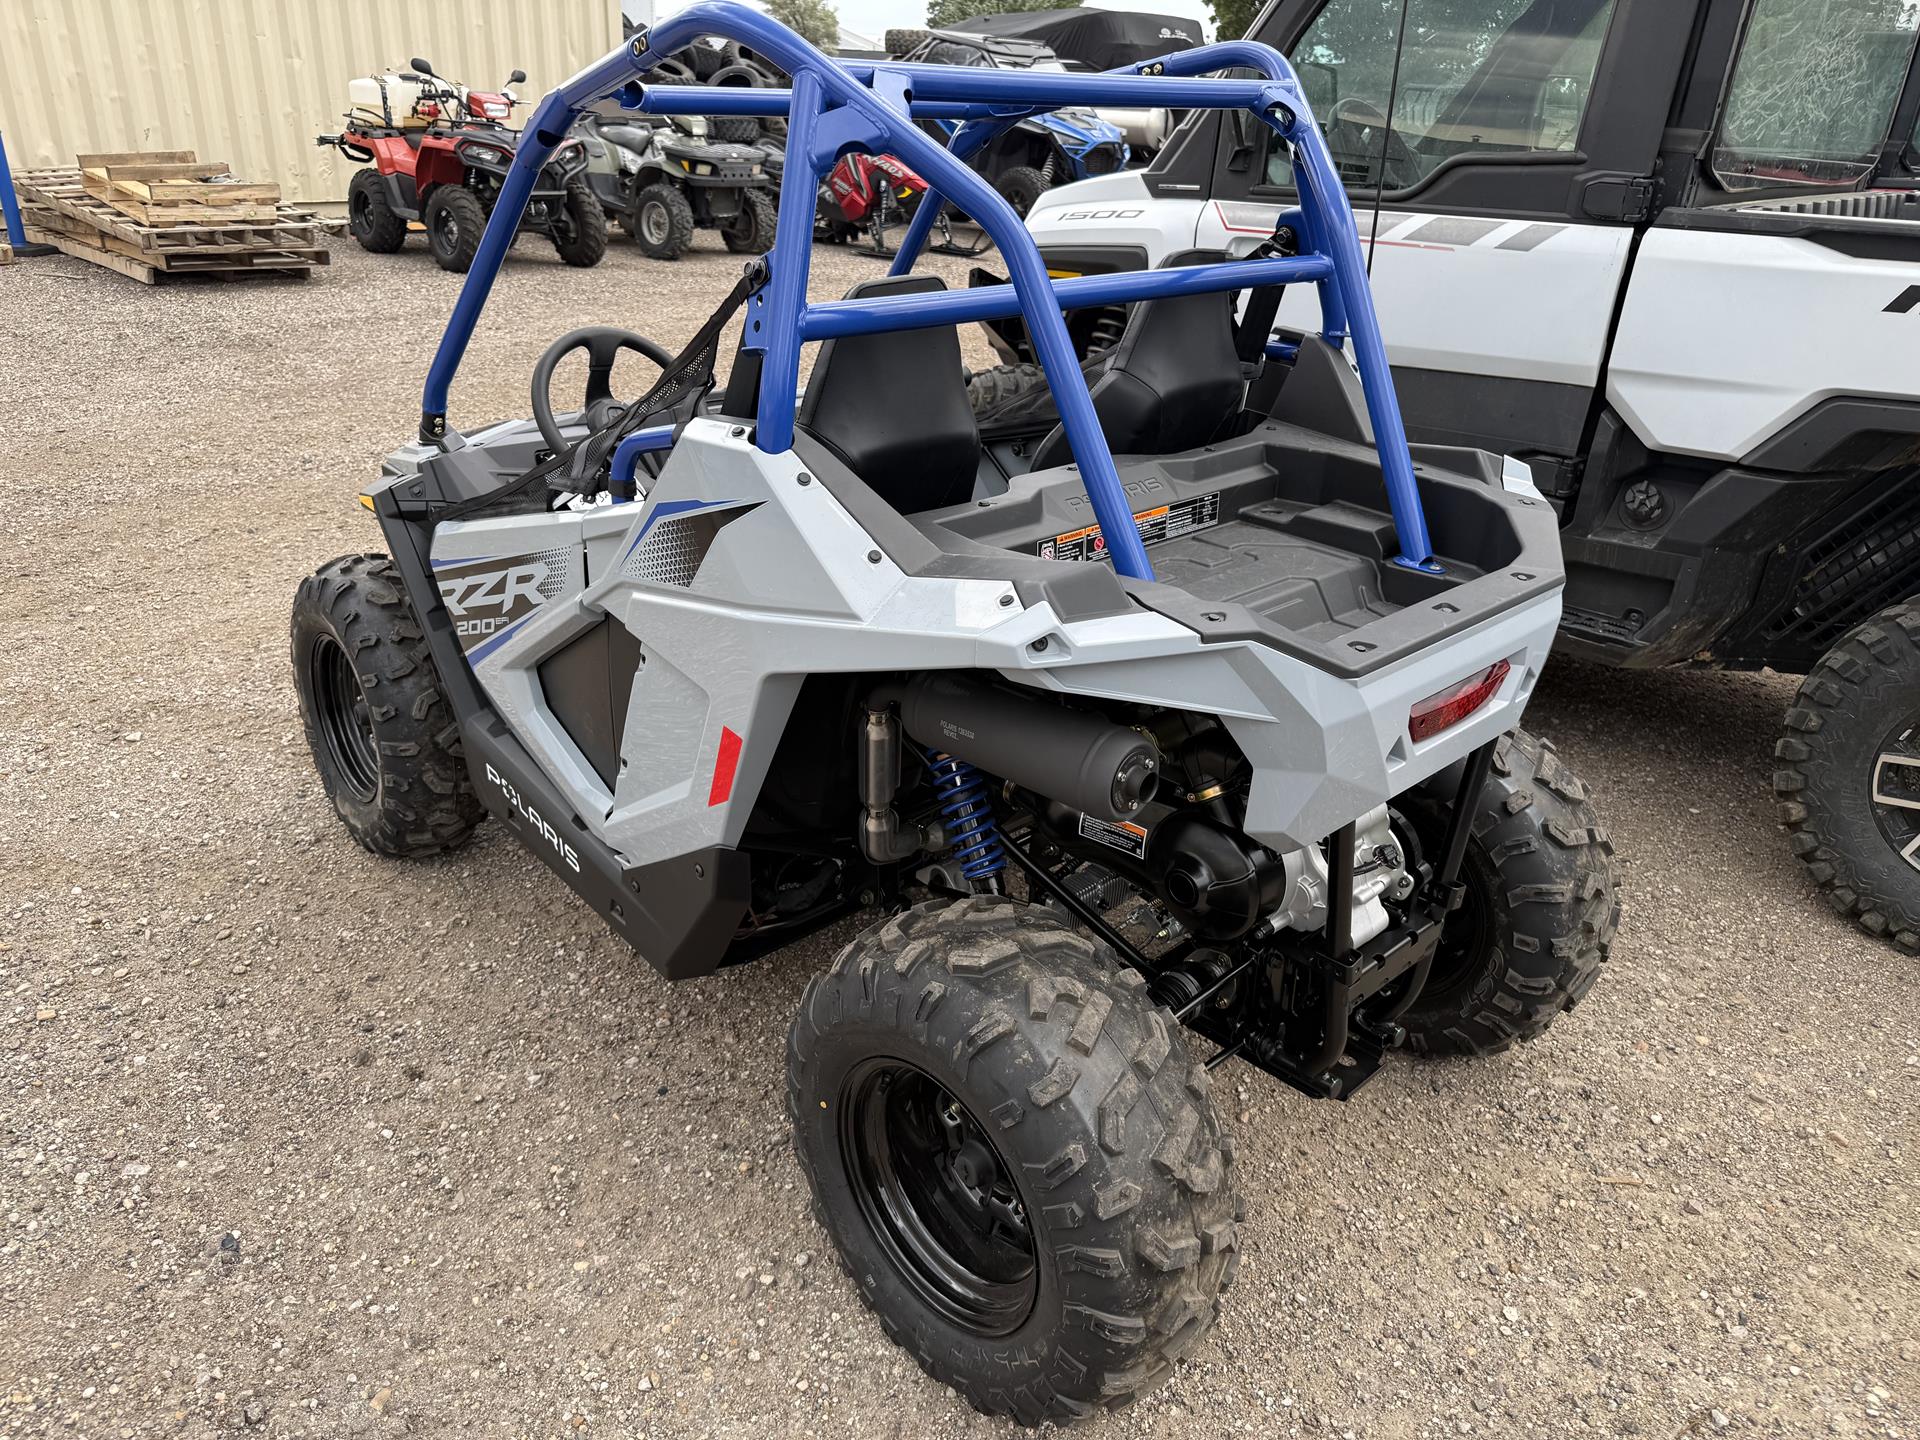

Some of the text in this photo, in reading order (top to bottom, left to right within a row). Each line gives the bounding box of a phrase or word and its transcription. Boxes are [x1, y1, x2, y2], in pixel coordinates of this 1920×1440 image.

[1057, 209, 1146, 222] 1500
[437, 562, 550, 616] RZR
[456, 618, 495, 636] 200
[486, 763, 580, 873] POLARIS
